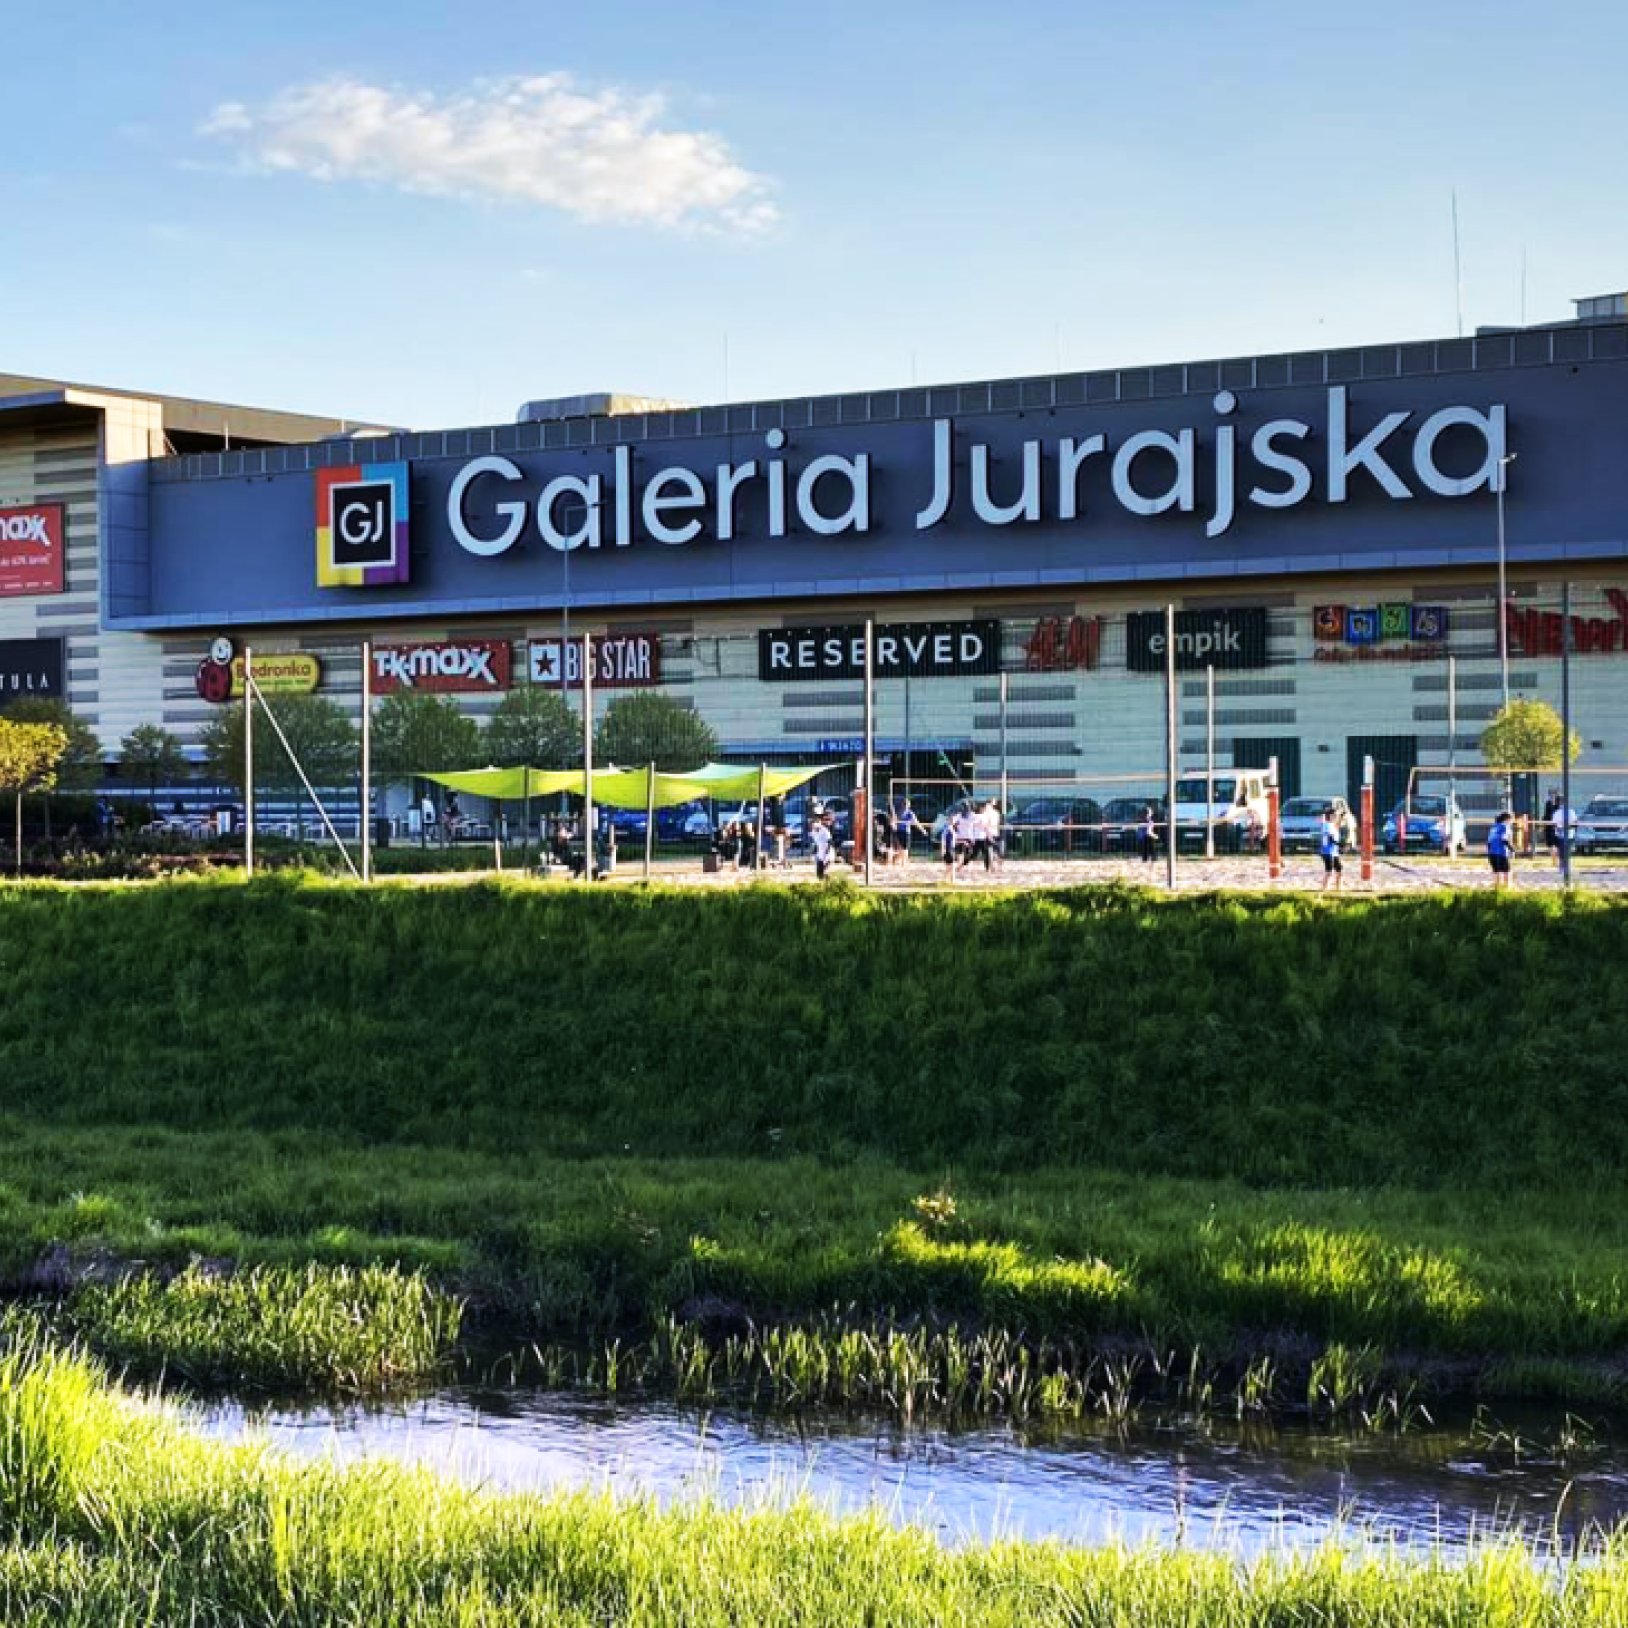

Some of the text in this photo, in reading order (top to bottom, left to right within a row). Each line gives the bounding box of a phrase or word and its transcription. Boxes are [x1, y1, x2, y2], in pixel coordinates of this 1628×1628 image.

[448, 385, 1507, 556] Galeria Jurajska
[340, 500, 384, 544] GJ
[602, 636, 651, 681] STAR
[771, 634, 983, 668] RESERVED
[1148, 621, 1240, 658] empik
